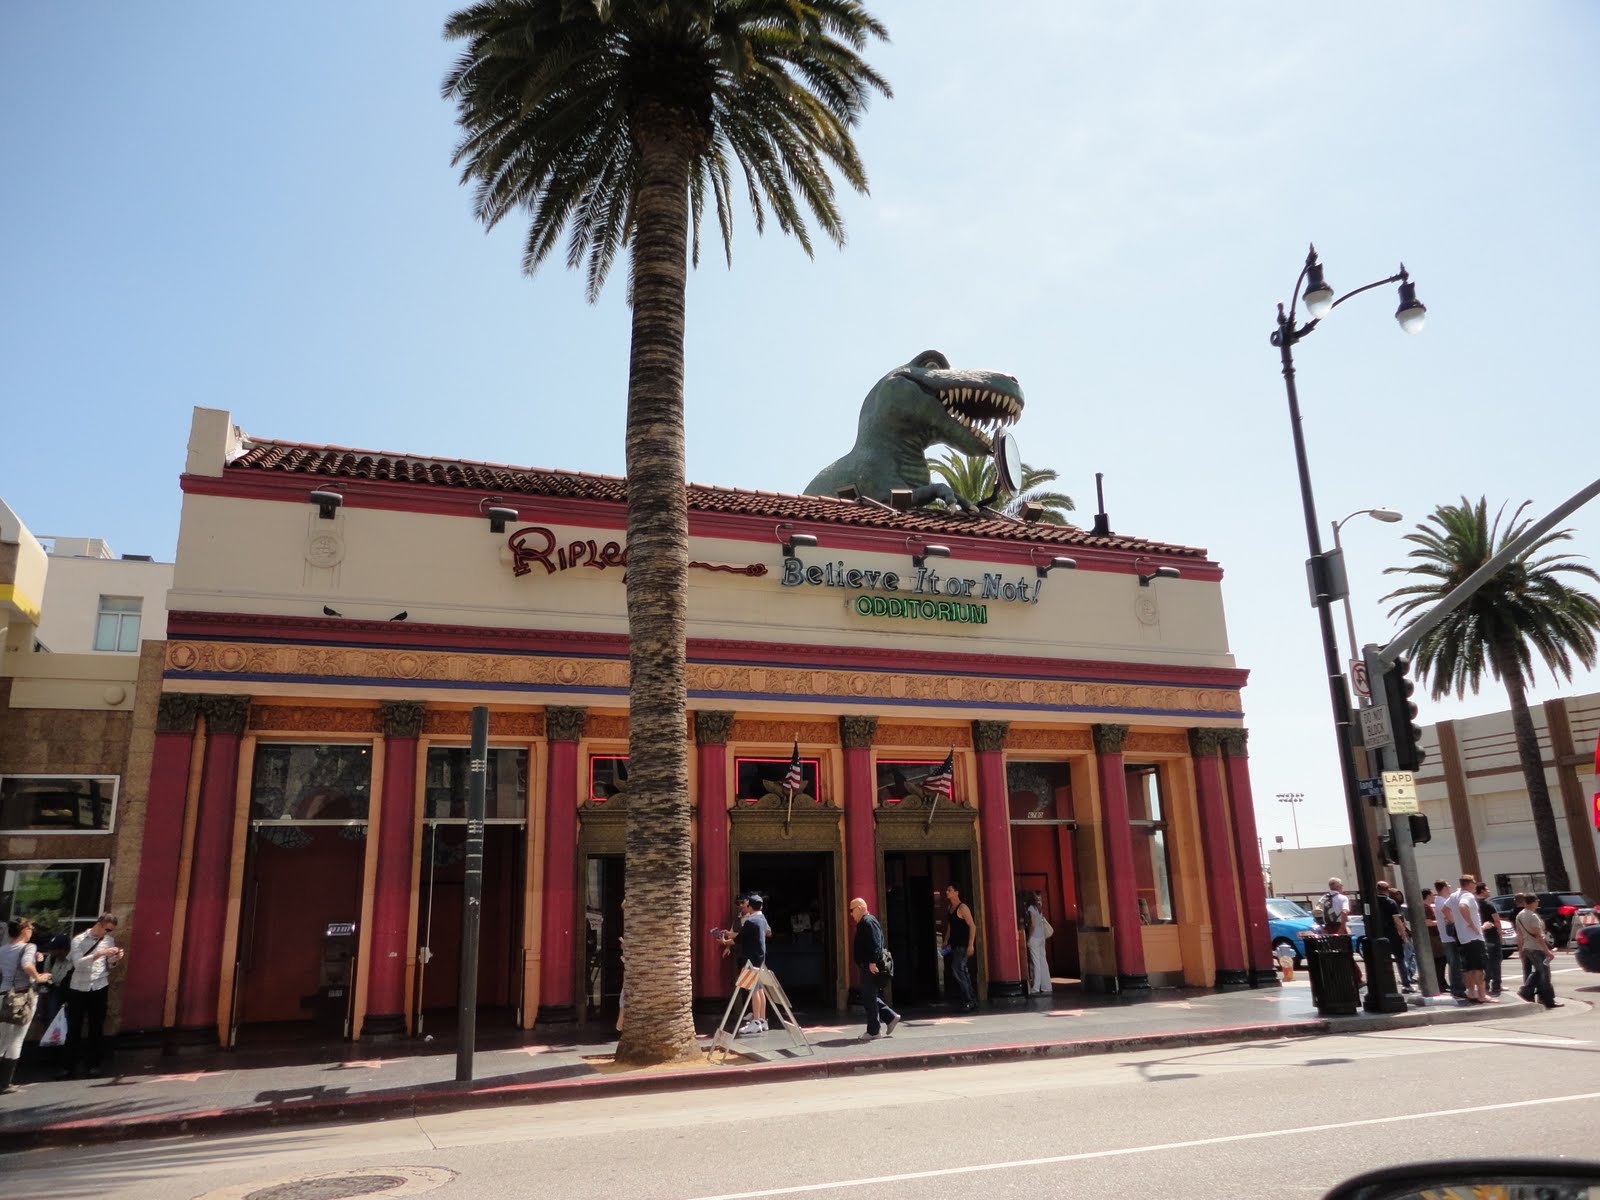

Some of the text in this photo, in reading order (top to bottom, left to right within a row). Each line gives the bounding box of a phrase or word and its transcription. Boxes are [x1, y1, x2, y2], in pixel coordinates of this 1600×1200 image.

[782, 557, 899, 591] Believe
[912, 567, 940, 595] It
[945, 577, 976, 597] or
[982, 573, 1042, 604] Not!
[855, 595, 988, 624] ODDITORIUM
[1363, 708, 1384, 724] DO NOT
[1366, 722, 1385, 737] BLOCK
[1359, 780, 1374, 790] land
[1384, 774, 1412, 783] LAPD
